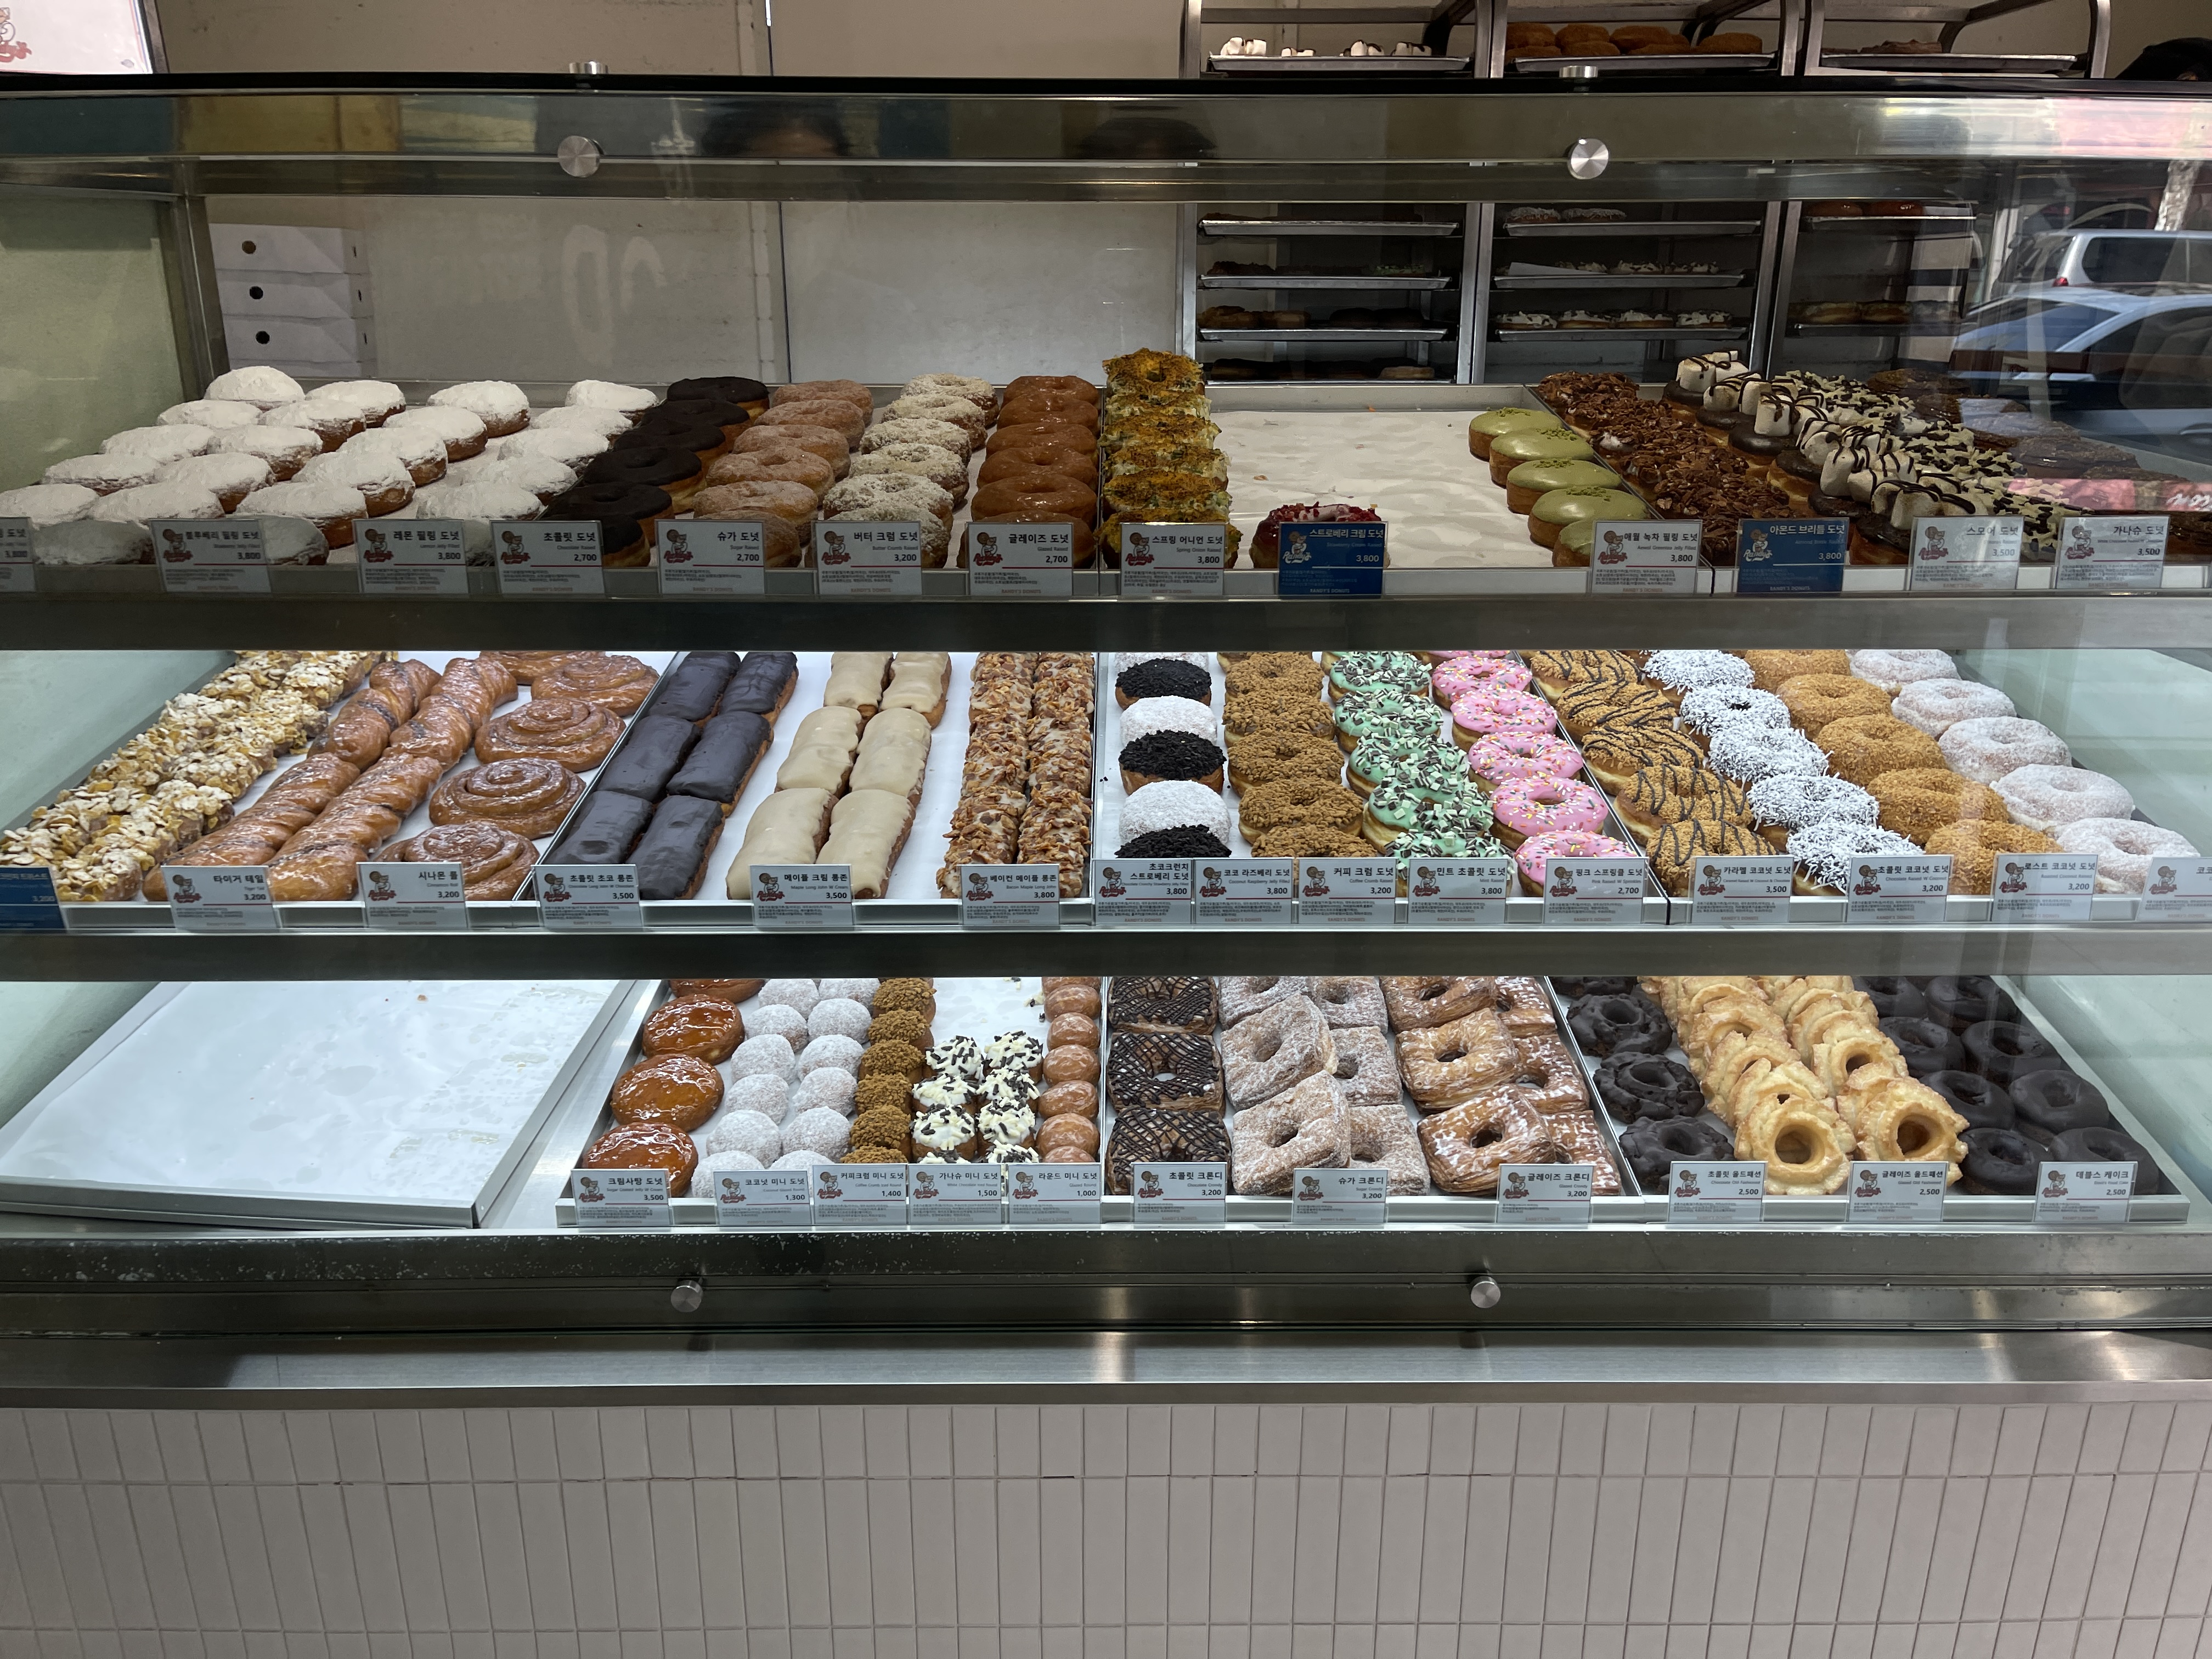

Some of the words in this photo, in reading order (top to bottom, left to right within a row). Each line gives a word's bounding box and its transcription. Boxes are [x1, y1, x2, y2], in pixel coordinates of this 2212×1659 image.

[7, 529, 27, 538] 도넛
[1309, 529, 1348, 539] 스트로베리
[1350, 529, 1366, 538] 크림
[1367, 529, 1384, 538] 도넛
[1770, 525, 1797, 535] 아몬드
[1827, 524, 1844, 536] 도넛
[1966, 526, 1996, 537] 스모어
[1999, 526, 2018, 535] 도넛
[2113, 526, 2142, 535] 가나슈
[2145, 526, 2164, 535] 도넛
[242, 532, 262, 540] 도넛
[393, 531, 413, 540] 레몬
[416, 531, 436, 540] 필링
[440, 531, 460, 540] 도넛
[544, 532, 573, 542] 초콜릿
[577, 532, 596, 541] 도넛
[717, 532, 737, 541] 슈가
[740, 532, 759, 541] 도넛
[854, 532, 872, 541] 버터
[877, 532, 895, 541] 크럼
[899, 532, 918, 541] 도넛
[1008, 534, 1047, 544] 글레이즈
[1050, 534, 1069, 543] 도넛
[1152, 536, 1176, 544] 스프링
[1180, 536, 1203, 544] 어니언
[1624, 533, 1640, 541] 애월
[1643, 533, 1660, 541] 녹차
[1663, 533, 1678, 541] 필링
[1681, 533, 1699, 543] 도넛
[1198, 556, 1220, 565] 3,800
[1149, 863, 1188, 871] 초코크런치
[1877, 866, 1901, 874] 초콜릿
[1933, 865, 1949, 874] 도넛
[2079, 862, 2096, 871] 도넛
[419, 871, 446, 880] 시나몬
[1334, 867, 1351, 876] 커피
[1355, 867, 1372, 876] 크럼
[1376, 867, 1393, 876] 도넛
[1437, 867, 1454, 876] 민트
[1458, 867, 1484, 876] 초콜릿
[1488, 867, 1505, 876] 도넛
[213, 875, 242, 883] 타이거
[2104, 1171, 2129, 1179] 케이크
